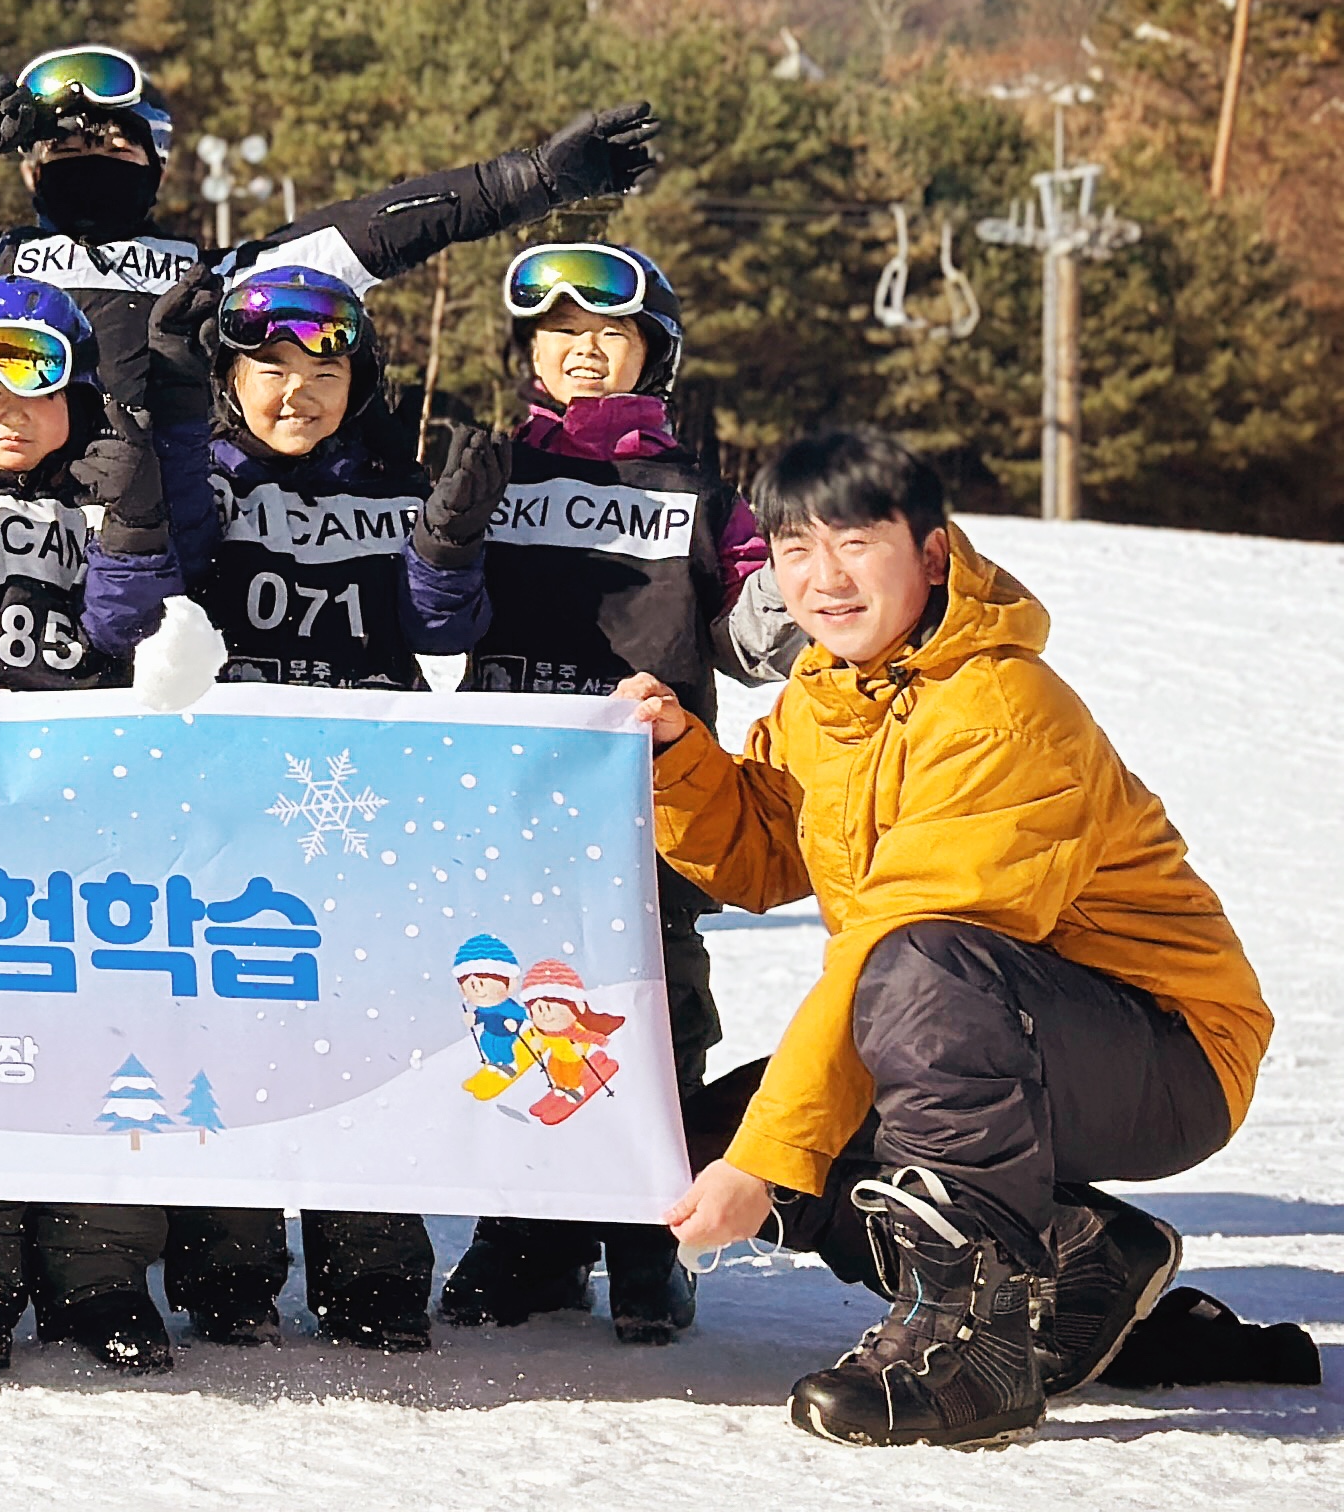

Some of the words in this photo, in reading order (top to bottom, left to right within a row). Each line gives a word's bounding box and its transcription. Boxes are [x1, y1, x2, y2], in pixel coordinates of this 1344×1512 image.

[18, 243, 75, 274] SKI
[487, 495, 550, 531] SKI
[565, 495, 691, 541] CAMP
[246, 571, 365, 638] 071
